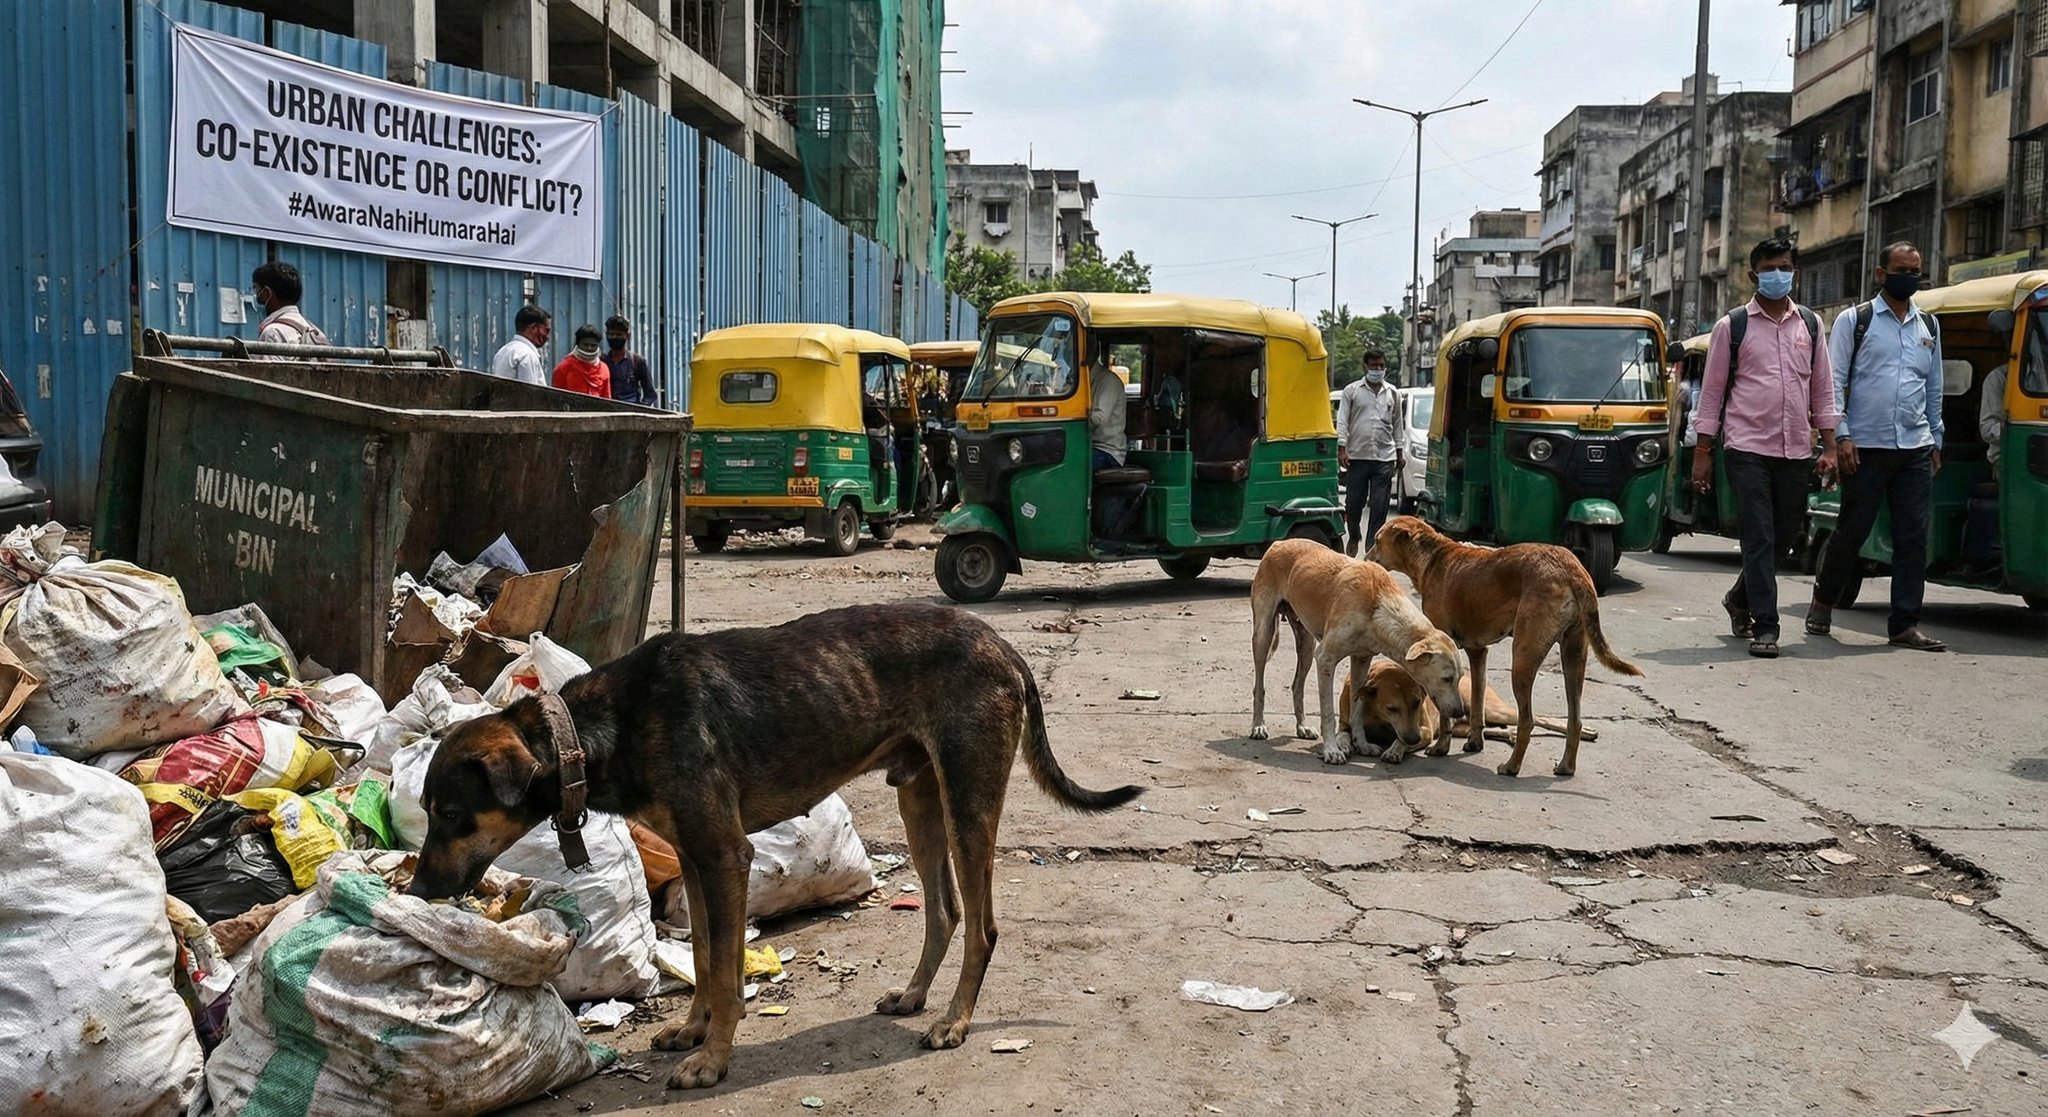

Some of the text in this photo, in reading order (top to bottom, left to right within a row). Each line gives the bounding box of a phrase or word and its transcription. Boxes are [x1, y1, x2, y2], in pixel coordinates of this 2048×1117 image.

[267, 79, 542, 165] URBAN CHALLENGES:
[196, 118, 583, 216] CO-EXISTENCE OR CONFLICT?
[288, 191, 516, 246] #AwaraNahiHumaraHai
[195, 465, 319, 535] MUNICIPAL
[235, 529, 277, 577] BIN
